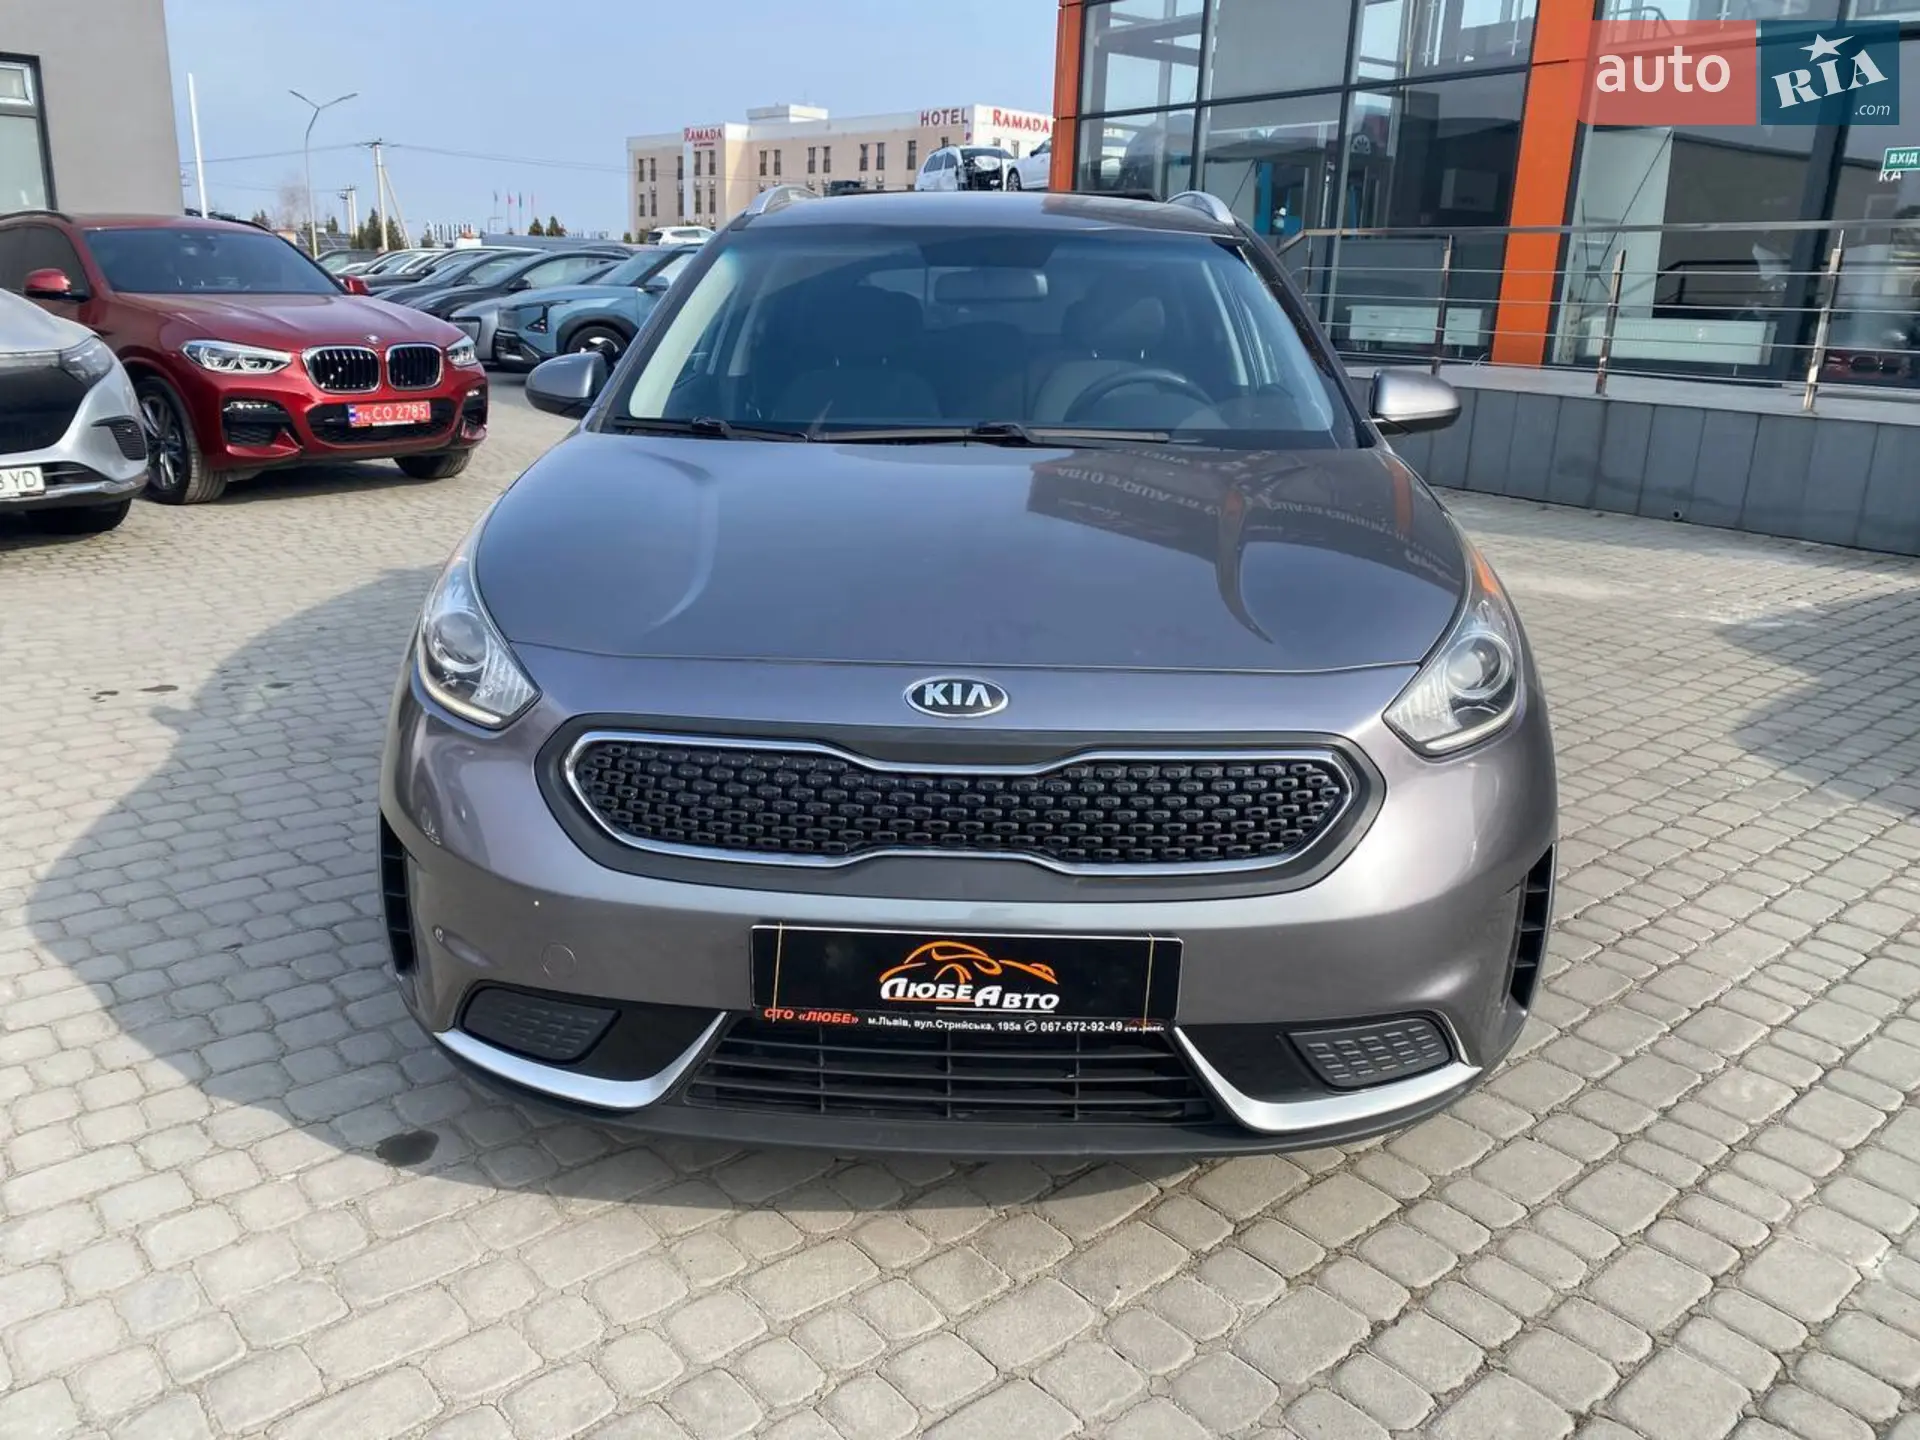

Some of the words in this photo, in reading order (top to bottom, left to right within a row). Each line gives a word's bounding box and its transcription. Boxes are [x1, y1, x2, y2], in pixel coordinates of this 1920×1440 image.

[920, 108, 968, 126] HOTEL
[992, 109, 1049, 133] RAMADA
[684, 127, 723, 142] RAMADA
[1890, 152, 1918, 164] ВХІД
[924, 682, 992, 707] KIA
[764, 1008, 794, 1020] СТО
[1040, 1021, 1123, 1032] 067-672-92-49
